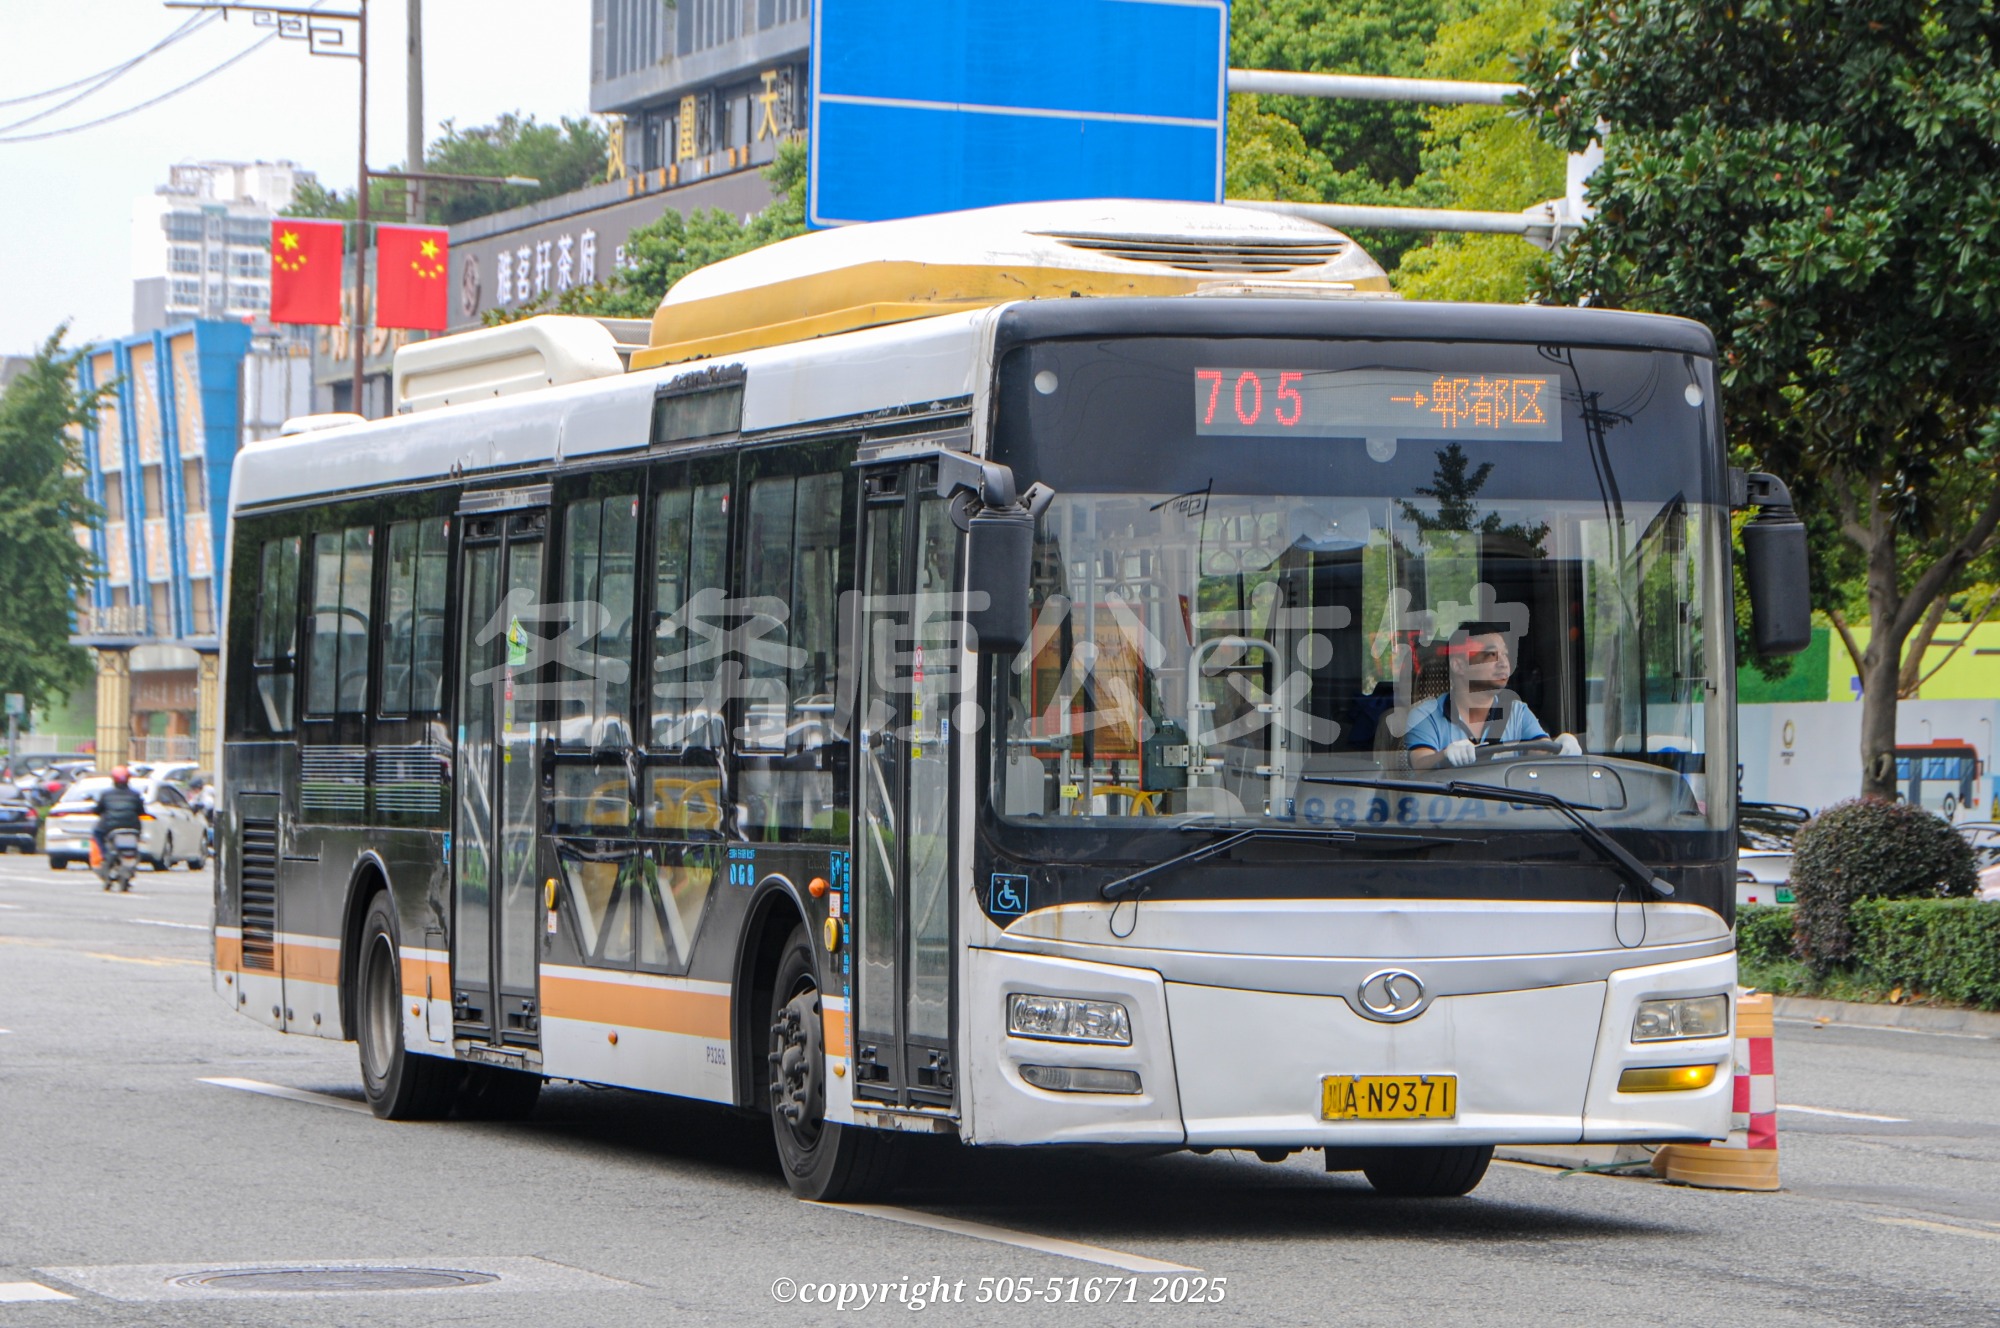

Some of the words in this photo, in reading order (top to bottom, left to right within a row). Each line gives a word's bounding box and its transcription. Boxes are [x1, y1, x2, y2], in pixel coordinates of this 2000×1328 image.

[1196, 370, 1303, 427] 705
[1430, 375, 1547, 429] 郫都区
